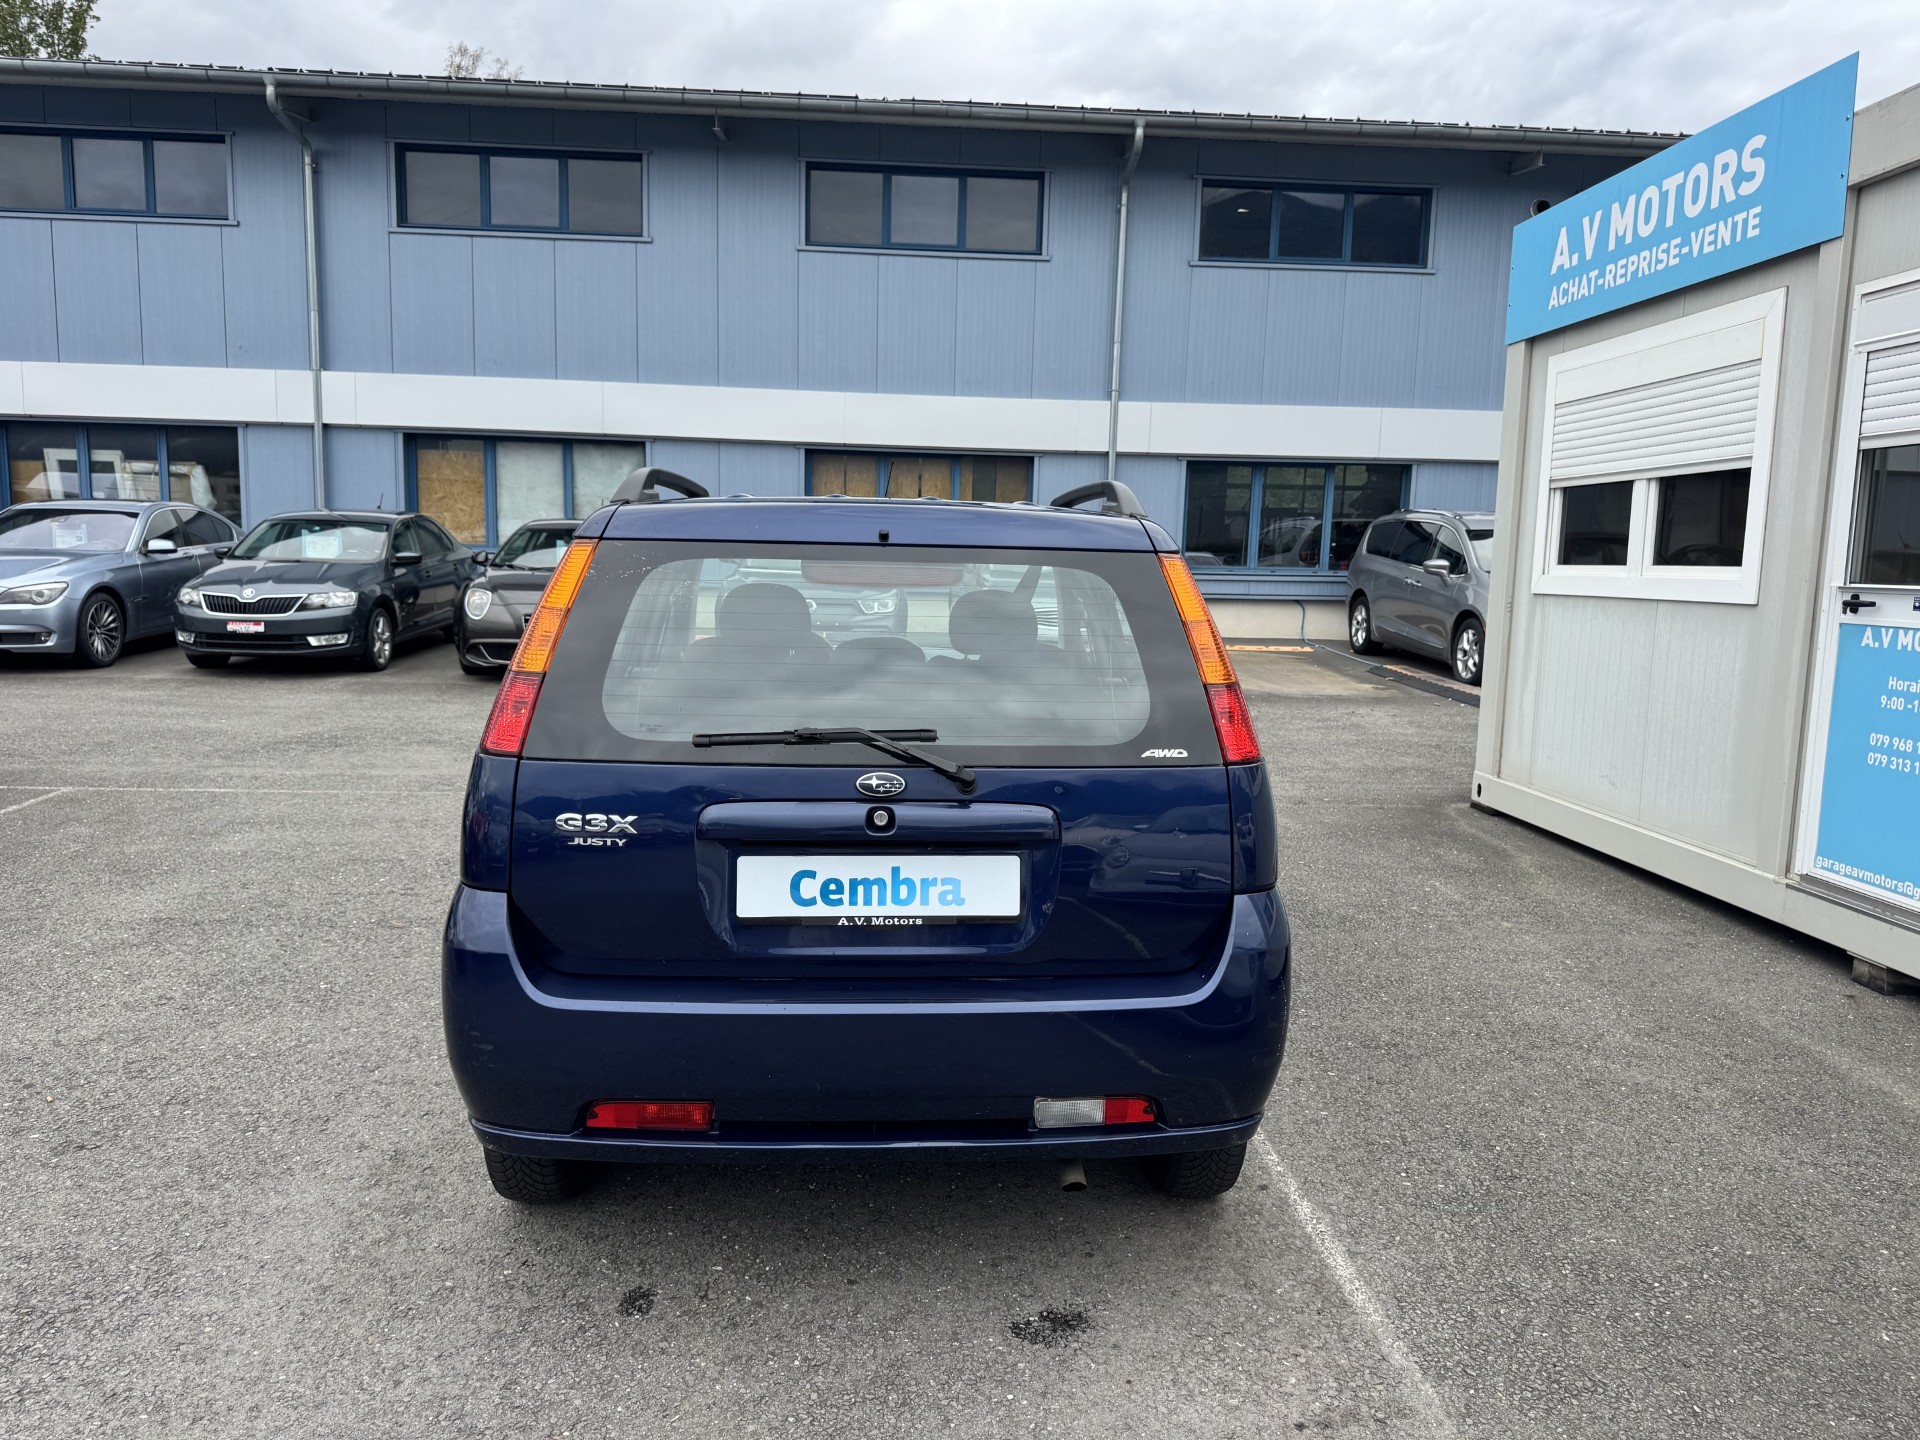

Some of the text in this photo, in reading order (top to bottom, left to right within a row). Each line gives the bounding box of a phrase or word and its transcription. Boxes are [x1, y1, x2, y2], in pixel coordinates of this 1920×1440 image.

[1550, 134, 1767, 276] A.V MOTORS
[1548, 205, 1762, 311] ACHAT-REPRISE-VENTE
[1860, 626, 1894, 649] A.V
[1880, 695, 1920, 714] 9:00 -1
[1141, 748, 1189, 758] AWD
[1869, 733, 1890, 749] 079
[1893, 737, 1913, 753] 968
[1867, 752, 1888, 768] 079
[1890, 756, 1911, 773] 313
[555, 812, 639, 834] G3X
[567, 837, 627, 847] JUSTY
[789, 865, 966, 908] Cembra
[837, 916, 923, 926] A.V. Motors
